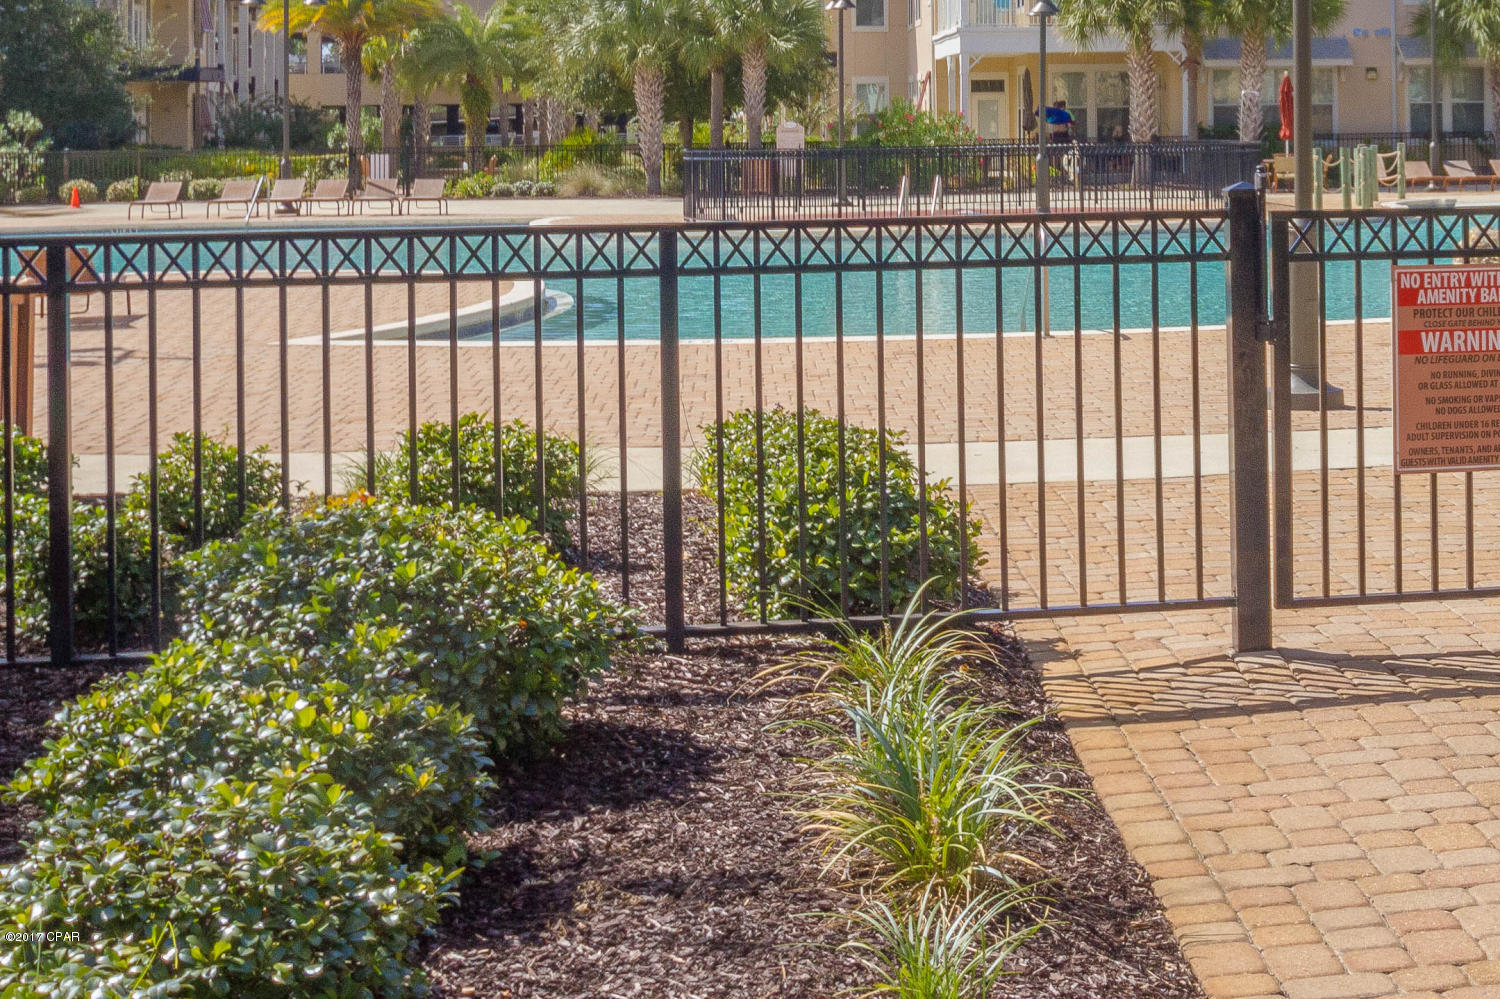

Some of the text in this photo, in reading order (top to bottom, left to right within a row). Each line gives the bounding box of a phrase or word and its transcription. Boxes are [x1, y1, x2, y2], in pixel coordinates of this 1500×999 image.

[1401, 273, 1420, 288] NO
[1424, 272, 1468, 288] ENTRY
[1417, 288, 1477, 304] AMENITY
[1413, 308, 1453, 318] PROTECT
[1456, 308, 1474, 317] OUR
[1430, 355, 1480, 363] LIFEGUARD
[1482, 354, 1496, 362] ON
[1443, 370, 1480, 378] RUNNING,
[1418, 382, 1428, 390] OR
[1430, 381, 1452, 390] GLASS
[1455, 380, 1488, 389] ALLOWED
[1438, 396, 1471, 404] SMOKING
[1416, 422, 1451, 430] CHILDREN
[1406, 433, 1429, 441] ADULT
[1431, 431, 1479, 440] SUPERVISION
[1409, 447, 1440, 455] OWNERS,
[1442, 446, 1475, 454] TENANTS,
[1401, 458, 1426, 466] GUESTS
[1468, 455, 1499, 464] AMENITY
